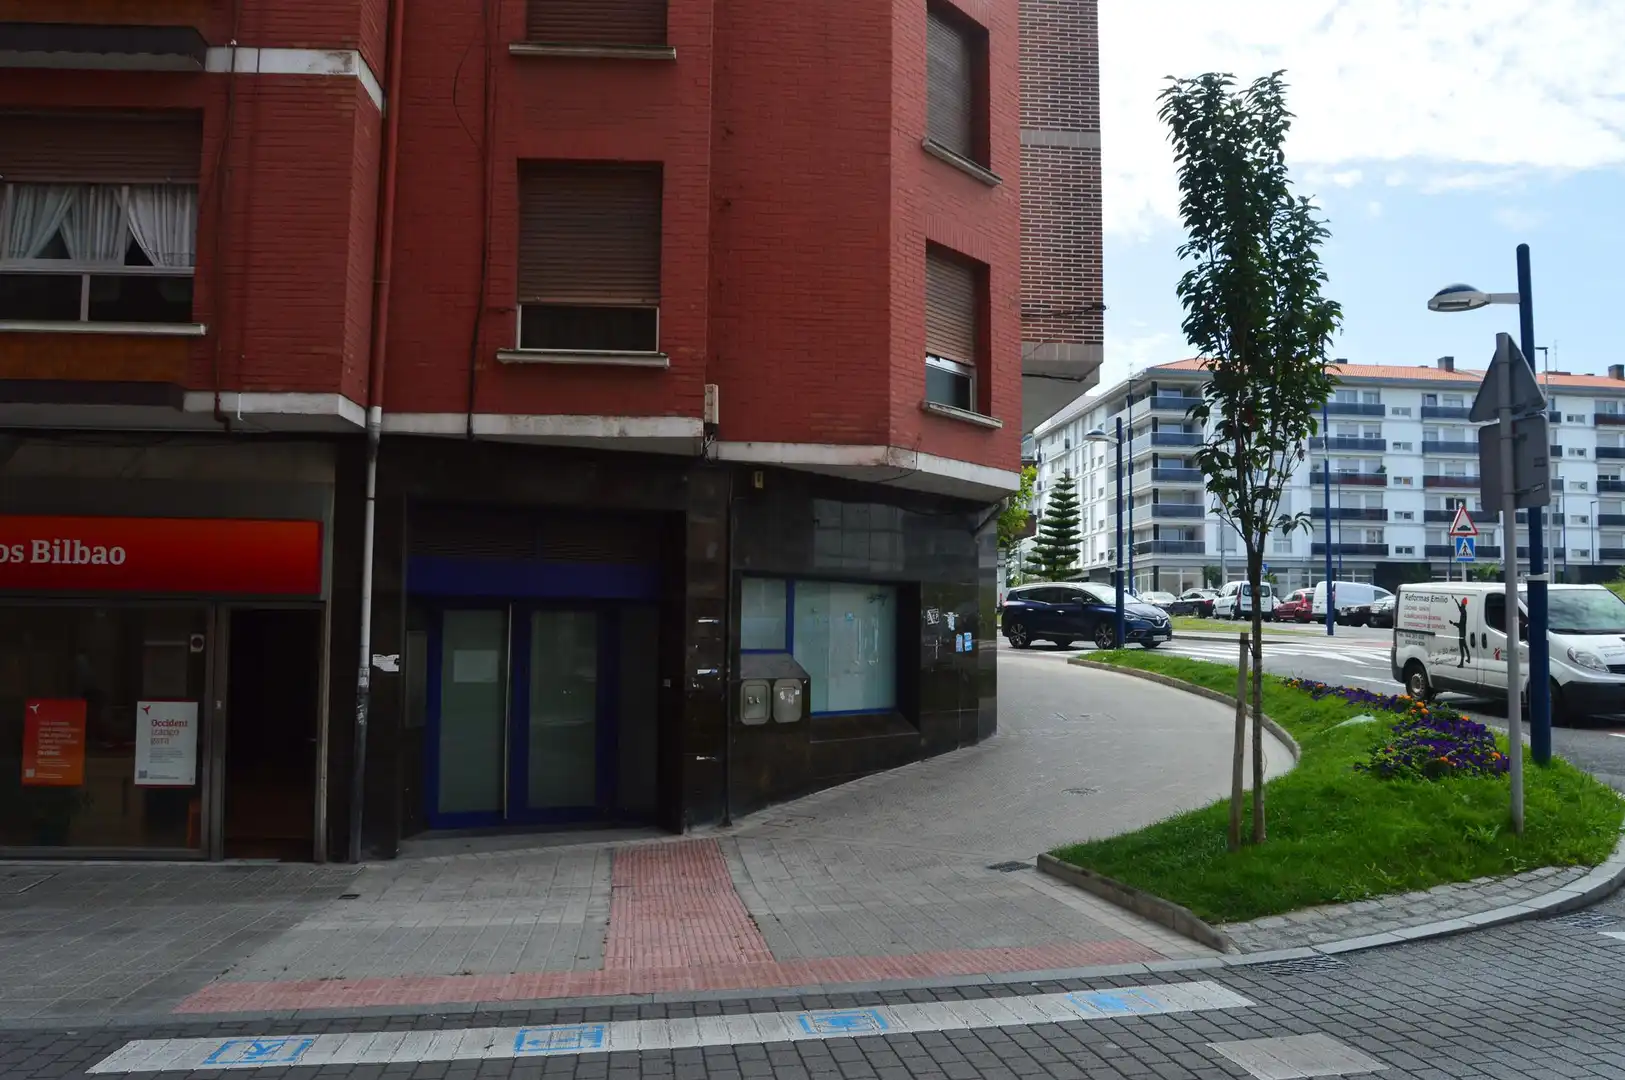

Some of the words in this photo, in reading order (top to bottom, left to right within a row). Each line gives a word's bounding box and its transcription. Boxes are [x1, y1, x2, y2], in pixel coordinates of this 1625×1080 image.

[30, 539, 126, 565] Bilbao
[1405, 593, 1430, 602] Reformas
[1431, 594, 1449, 604] Emilio
[151, 719, 188, 727] Occident
